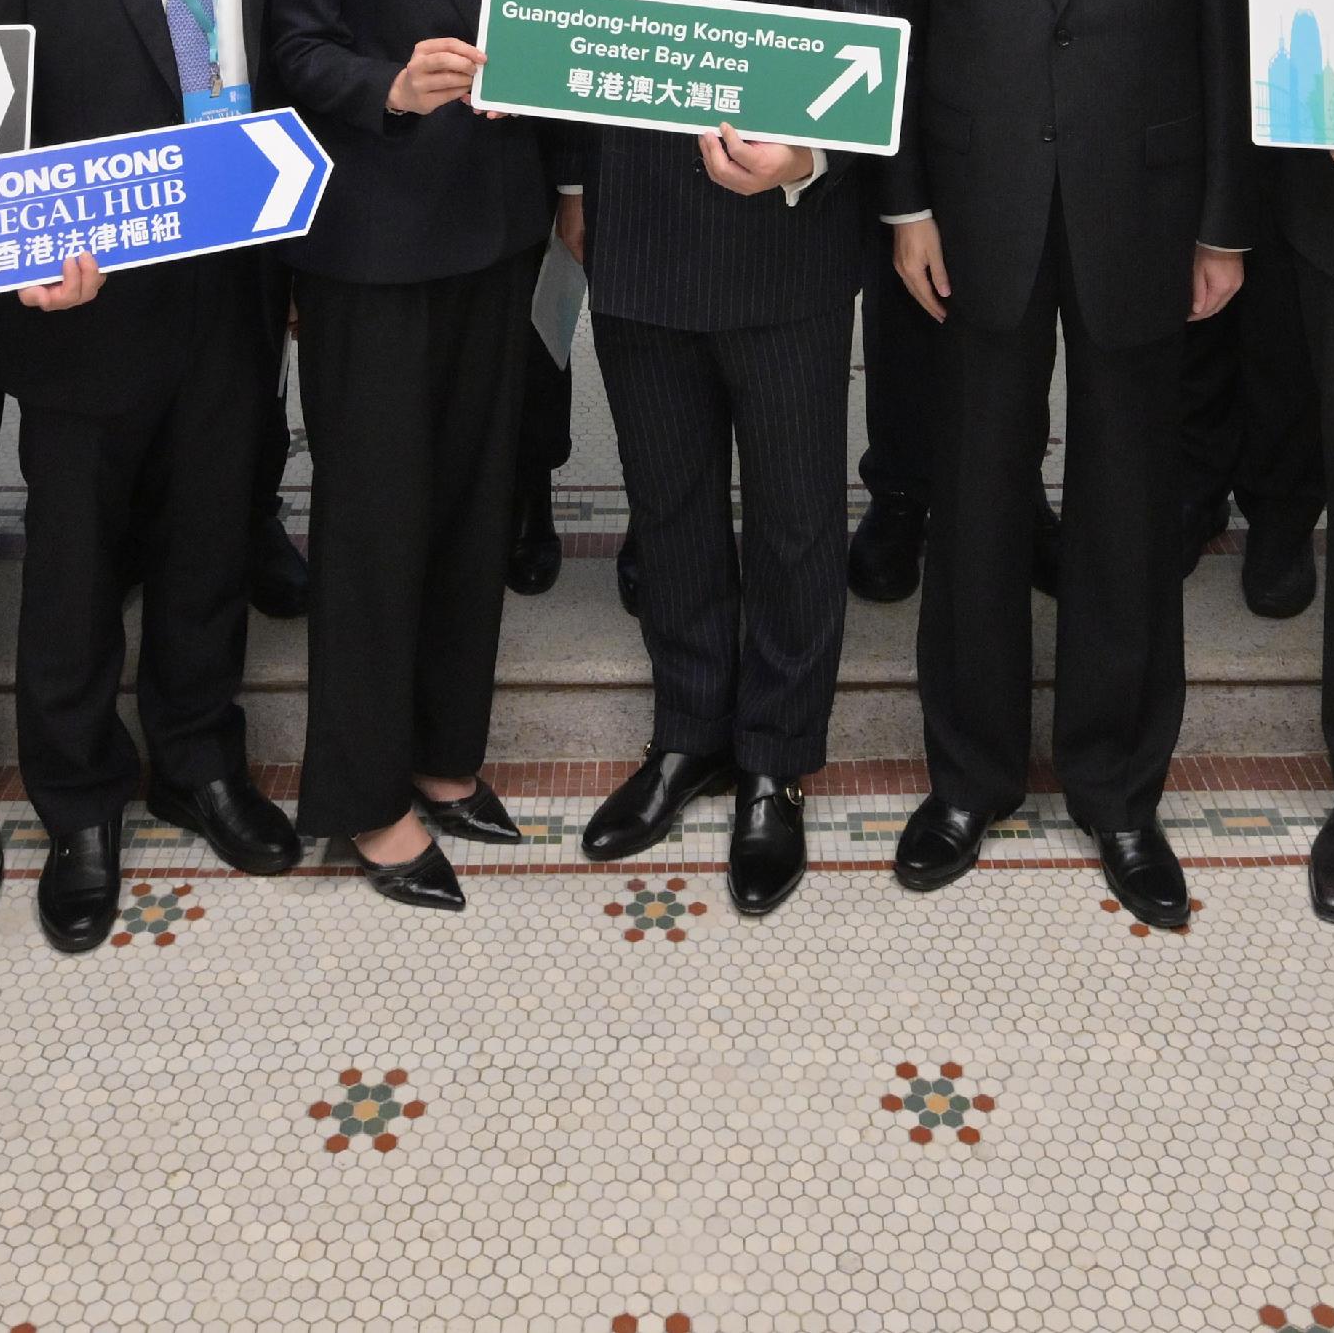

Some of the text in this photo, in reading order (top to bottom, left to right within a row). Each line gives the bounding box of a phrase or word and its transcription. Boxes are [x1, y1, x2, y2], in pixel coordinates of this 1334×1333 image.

[502, 0, 825, 54] Guangdong-Hong Kong-Macao
[570, 36, 749, 73] Greater Bay Area
[566, 67, 744, 114] 粵港澳大灣區
[83, 144, 185, 185] KONG
[102, 179, 187, 217] HUB
